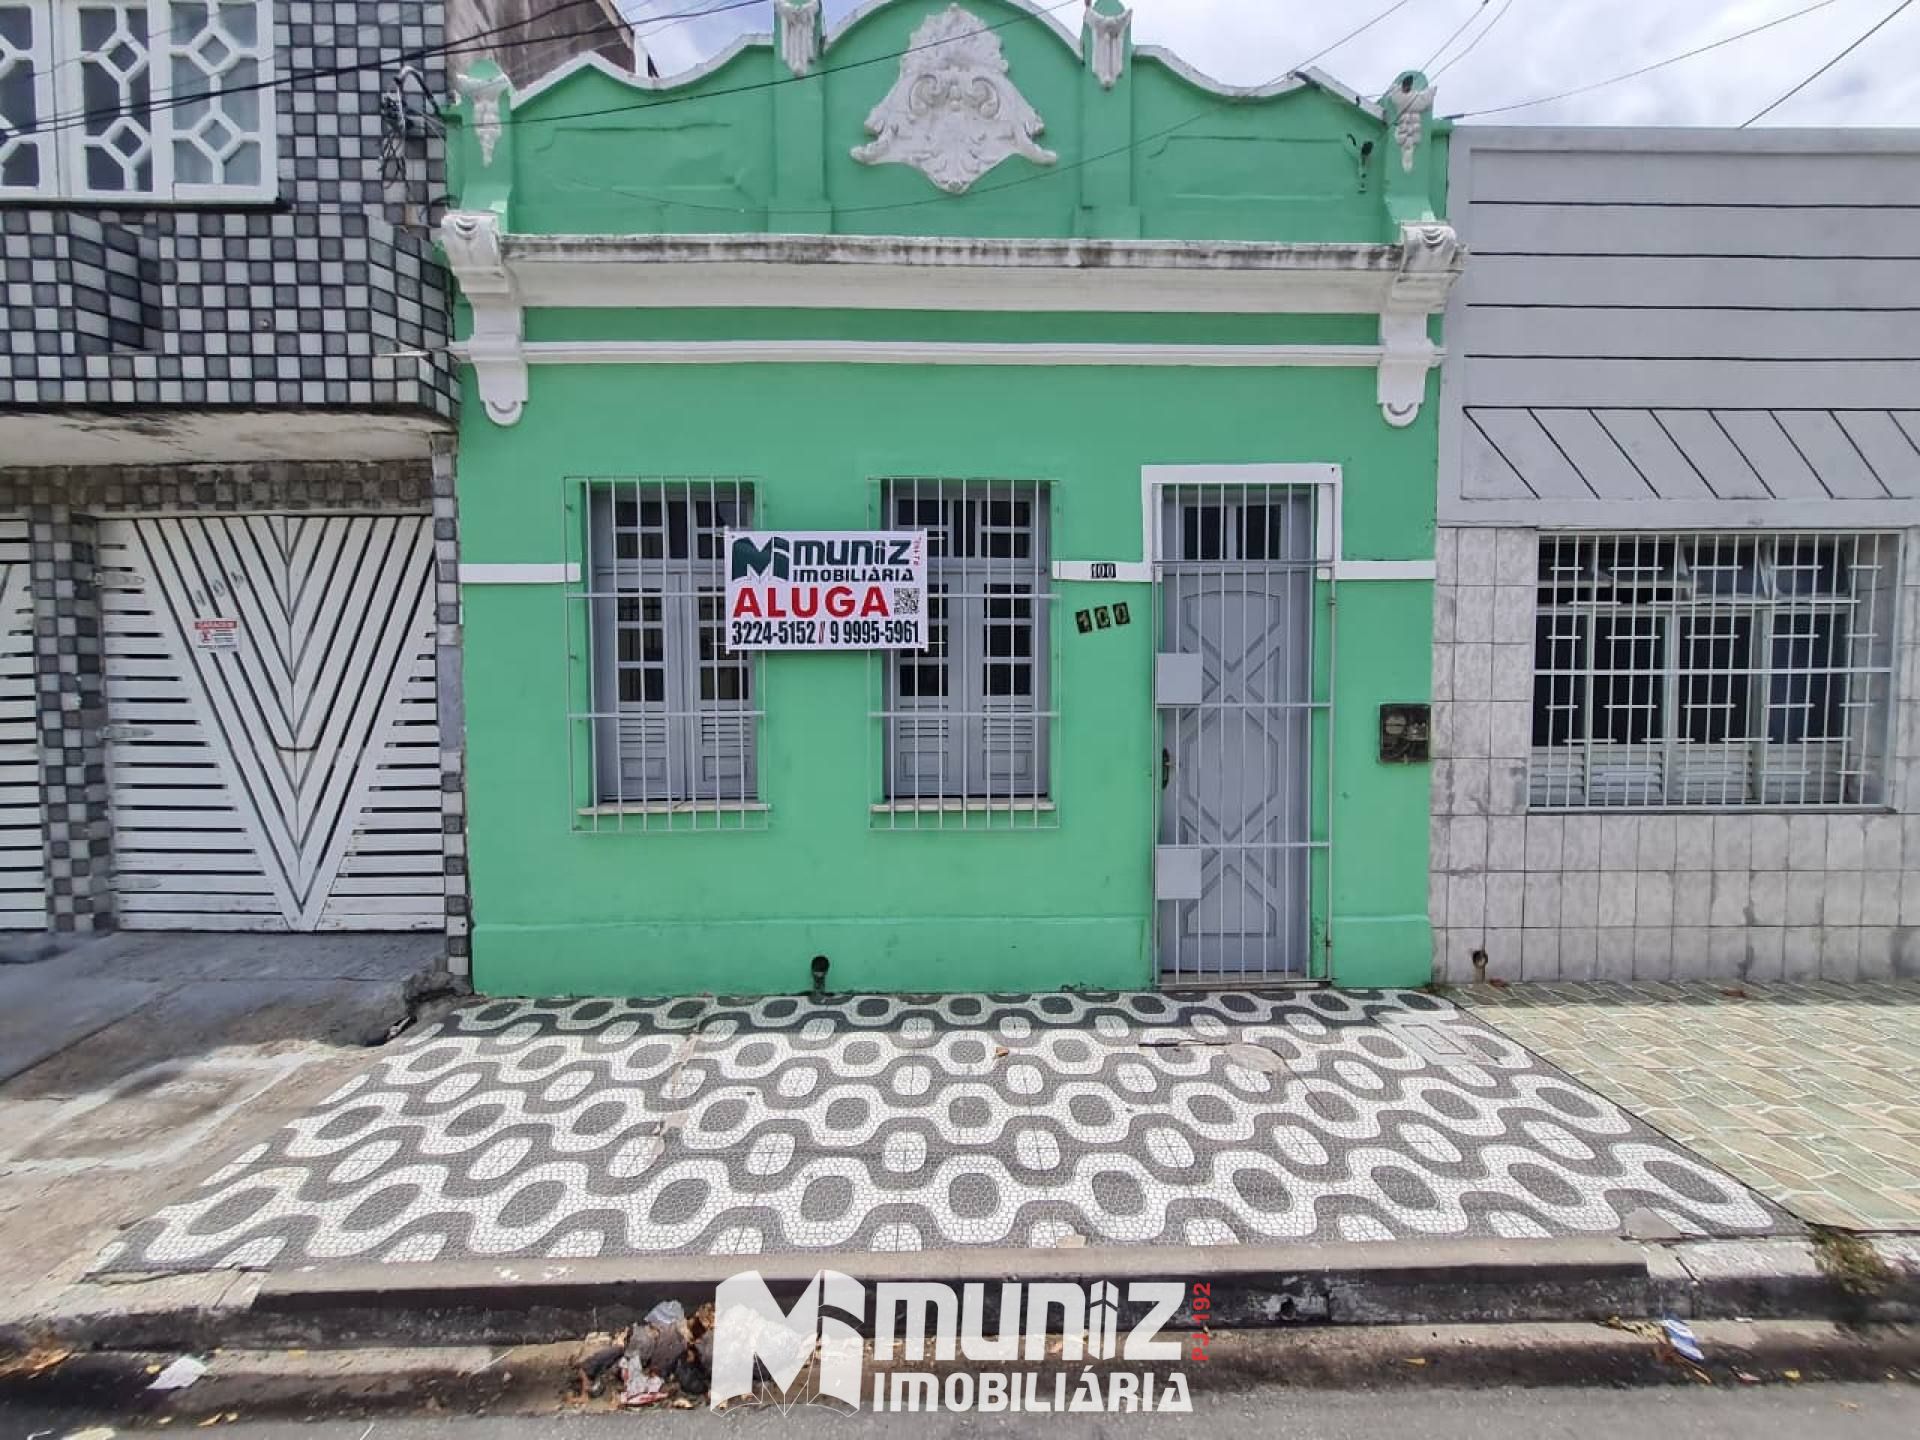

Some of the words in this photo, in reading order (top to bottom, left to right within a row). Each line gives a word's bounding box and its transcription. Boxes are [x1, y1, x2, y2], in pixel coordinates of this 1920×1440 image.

[793, 567, 914, 582] IMOBILIÁRIA
[1092, 564, 1115, 577] 100
[733, 586, 890, 618] ALUGA
[732, 621, 816, 645] 3224-5152
[830, 621, 839, 644] 9
[843, 620, 919, 644] 9995-5961
